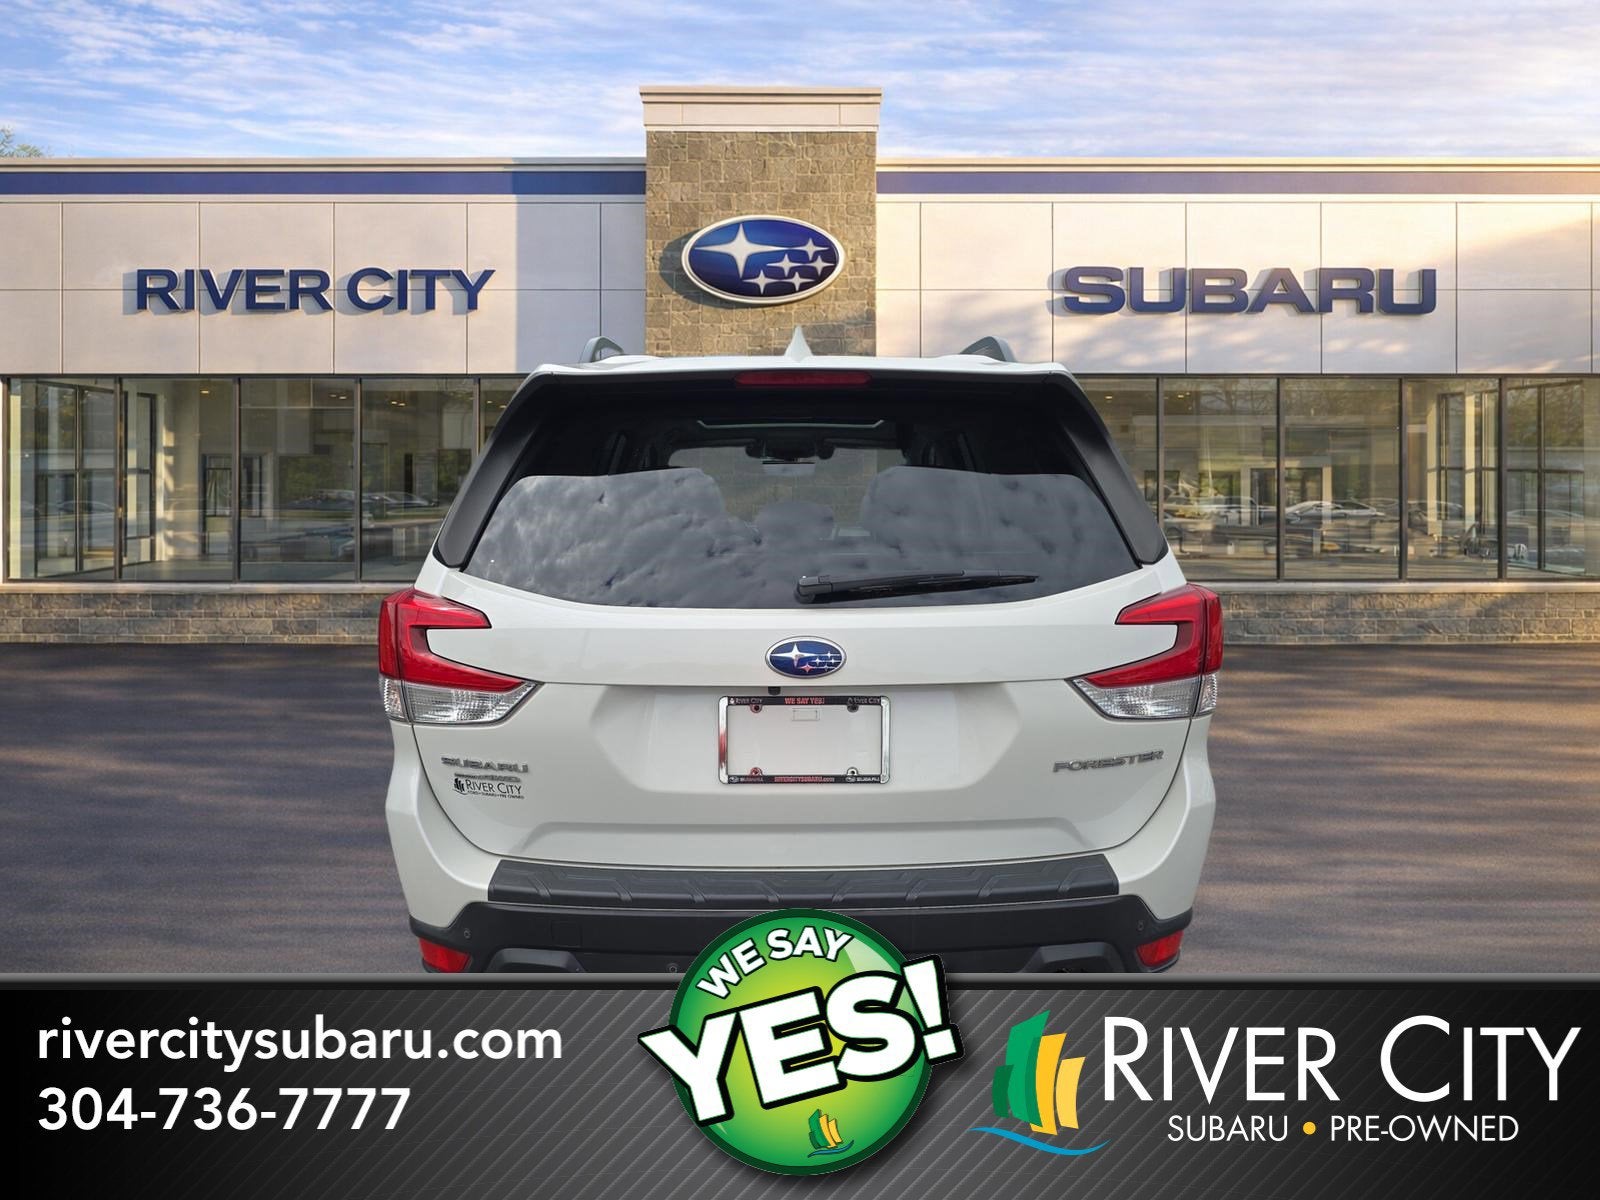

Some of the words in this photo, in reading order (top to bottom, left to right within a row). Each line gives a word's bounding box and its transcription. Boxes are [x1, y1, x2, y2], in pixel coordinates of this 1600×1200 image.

[136, 268, 335, 311] RIVER
[346, 267, 496, 311] CITY
[1063, 266, 1437, 314] SUBARU
[784, 697, 796, 705] WE
[796, 697, 809, 705] SAY
[809, 697, 825, 705] YES!
[441, 757, 529, 774] SUBARU
[1053, 750, 1164, 773] FORESTER
[465, 779, 496, 793] RIVER
[497, 782, 522, 795] CITY
